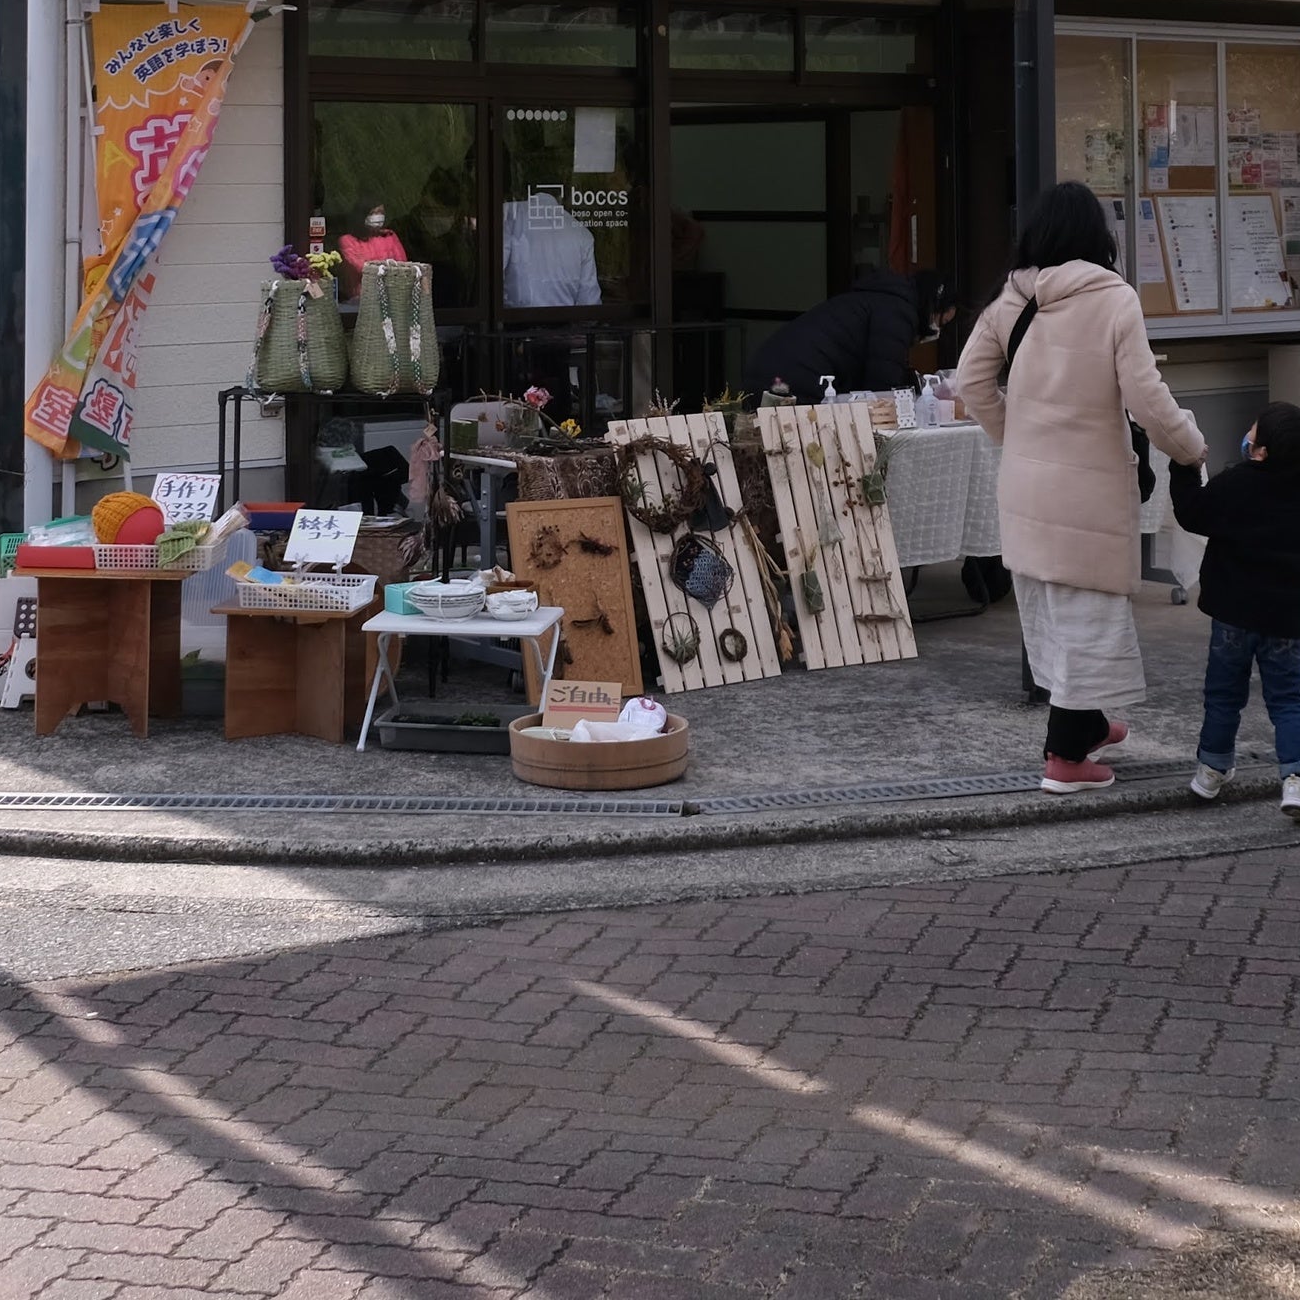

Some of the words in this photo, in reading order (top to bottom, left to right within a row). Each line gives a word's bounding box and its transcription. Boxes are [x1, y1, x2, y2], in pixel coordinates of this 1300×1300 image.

[105, 18, 201, 75] みんなと楽しく
[134, 38, 228, 82] 英語を学ぼう!
[571, 186, 628, 206] boccs
[571, 209, 591, 218] boso
[593, 210, 613, 219] open
[606, 220, 628, 229] space
[160, 480, 214, 499] 手作り
[297, 515, 339, 531] 絵本
[308, 531, 356, 541] コーナー
[550, 686, 620, 705] ご自由に
